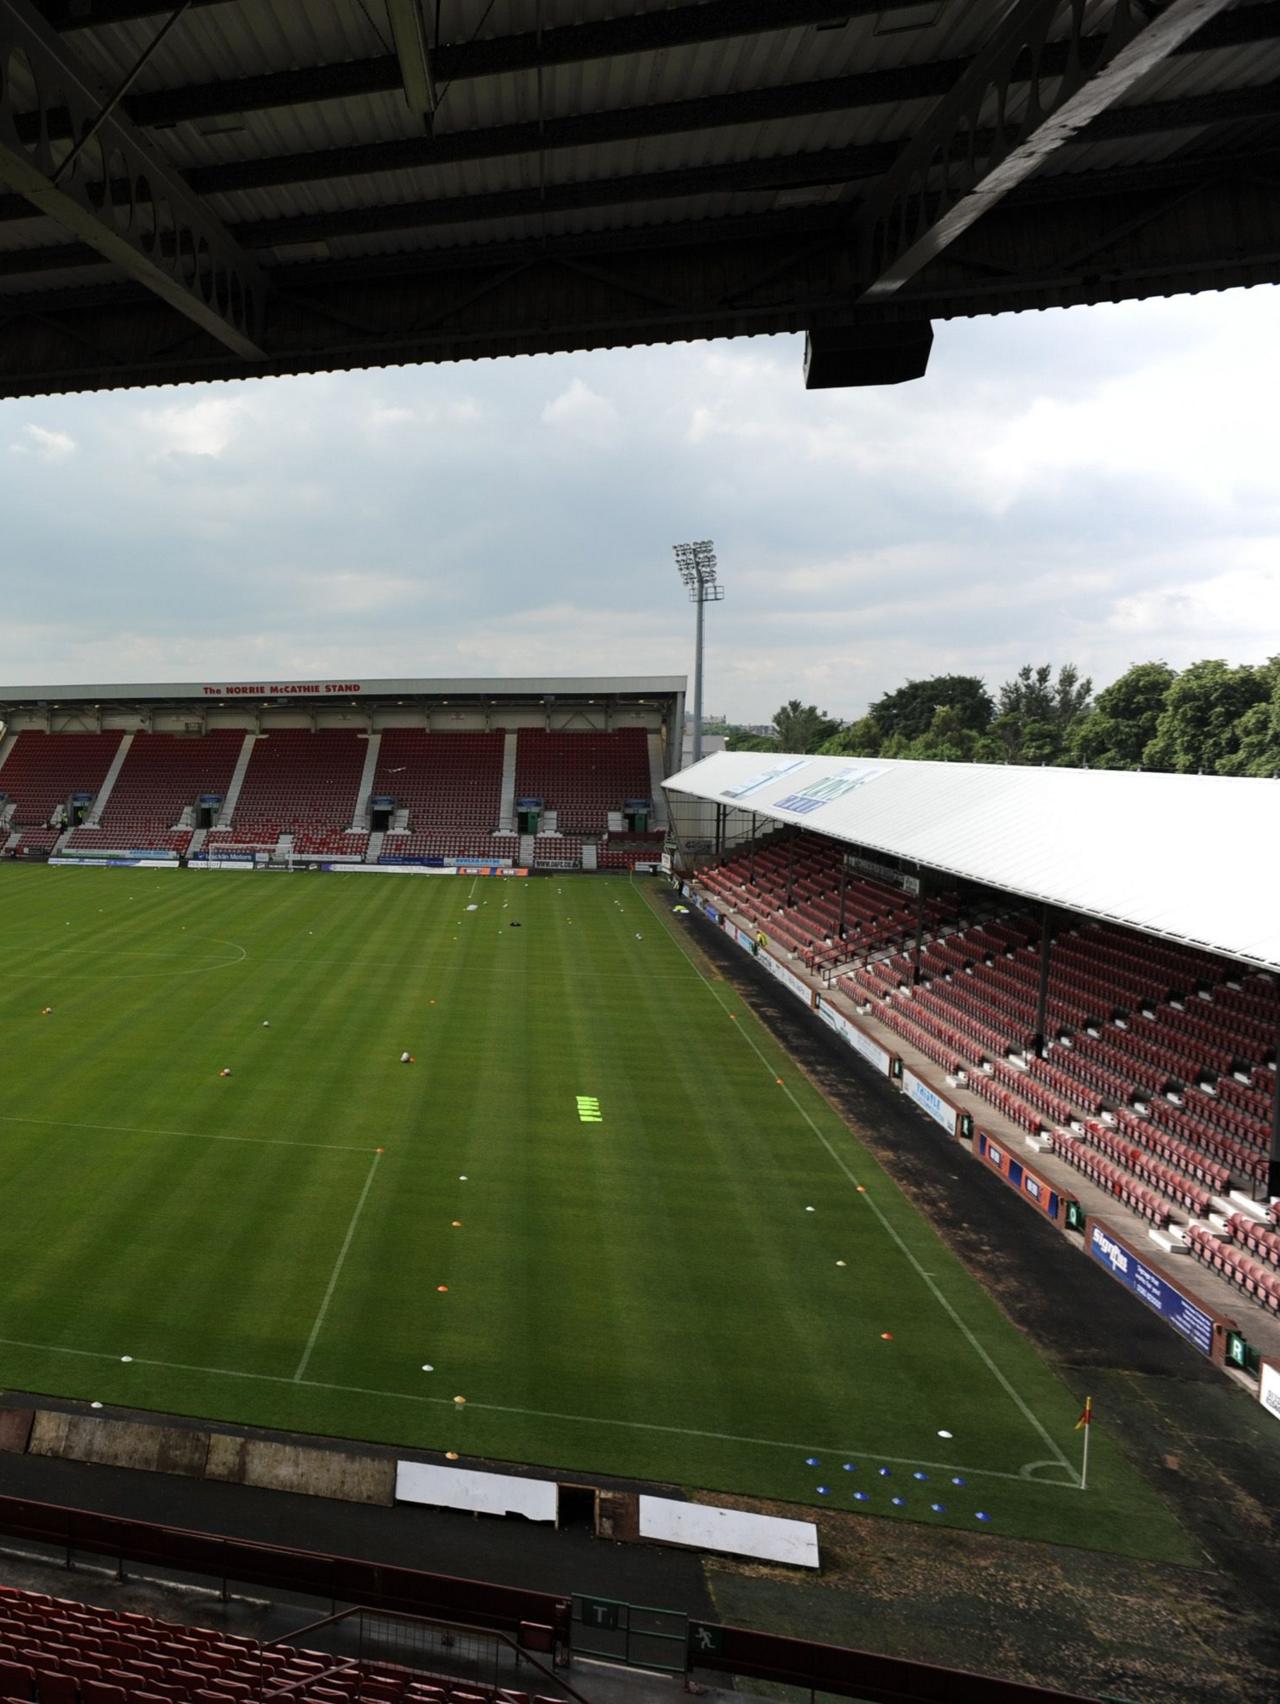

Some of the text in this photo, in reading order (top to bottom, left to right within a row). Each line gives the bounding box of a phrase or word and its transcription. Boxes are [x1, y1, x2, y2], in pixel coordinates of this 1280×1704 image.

[203, 684, 361, 695] The NORRIE McCATHIE STAND
[593, 1605, 608, 1623] T
